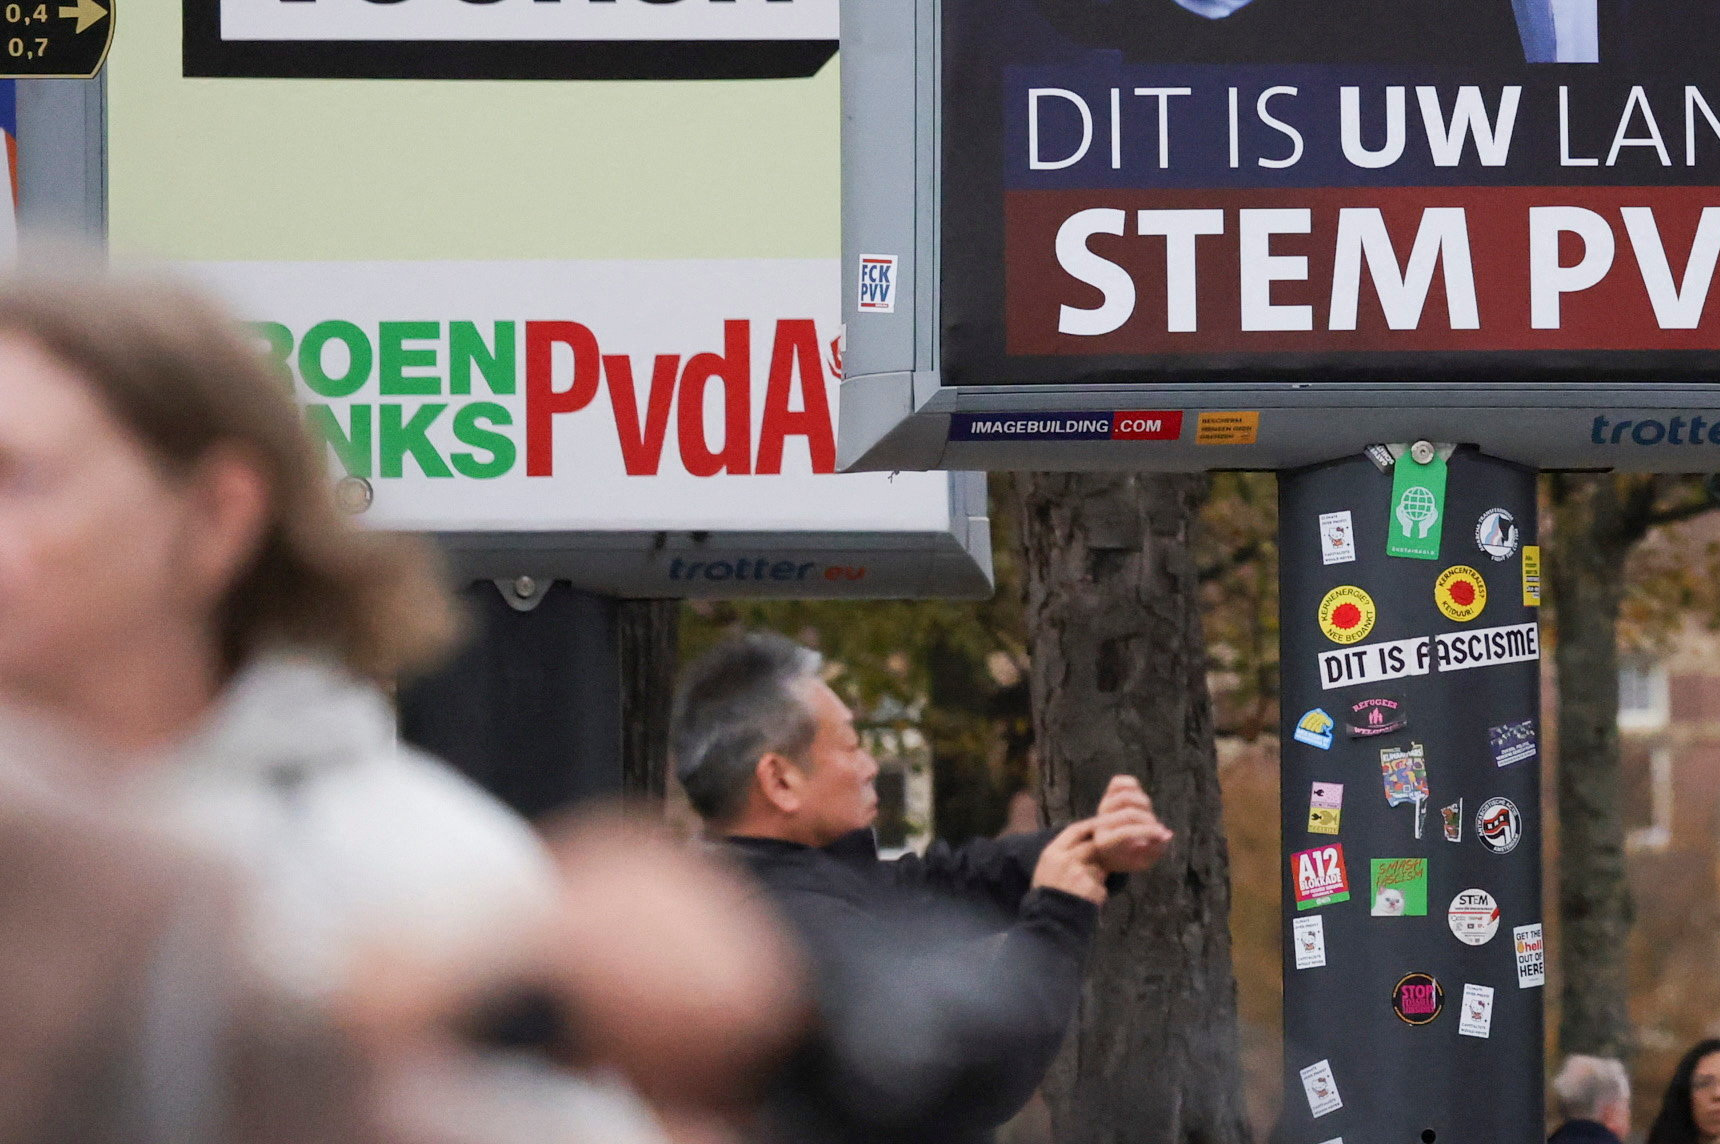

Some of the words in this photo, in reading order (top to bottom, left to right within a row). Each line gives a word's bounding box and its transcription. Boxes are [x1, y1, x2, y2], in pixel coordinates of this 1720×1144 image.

[5, 3, 48, 26] 0,4
[8, 37, 48, 60] 0,7
[1028, 87, 1192, 170] DIT
[1228, 85, 1304, 169] IS
[1339, 85, 1522, 169] UW
[862, 264, 891, 283] FCK
[1055, 207, 1480, 336] STEM
[861, 283, 890, 302] PVV
[236, 319, 516, 398] ROEN
[525, 319, 837, 478] PvdA
[305, 401, 516, 479] NKS
[1326, 628, 1344, 642] NEE
[1345, 610, 1374, 642] BEDANKT
[1325, 650, 1367, 683] DIT
[1379, 645, 1405, 674] IS
[1416, 627, 1537, 669] FASCISME
[1352, 698, 1398, 712] REFUGEES
[1299, 847, 1341, 880] A12
[1299, 872, 1342, 890] BLOKKADE
[1459, 894, 1489, 906] STEM
[1516, 931, 1529, 941] GET
[1530, 929, 1541, 938] THE
[1525, 939, 1542, 952] hell
[1519, 953, 1533, 963] OUT
[1520, 962, 1544, 977] HERE
[1401, 984, 1433, 999] STOP
